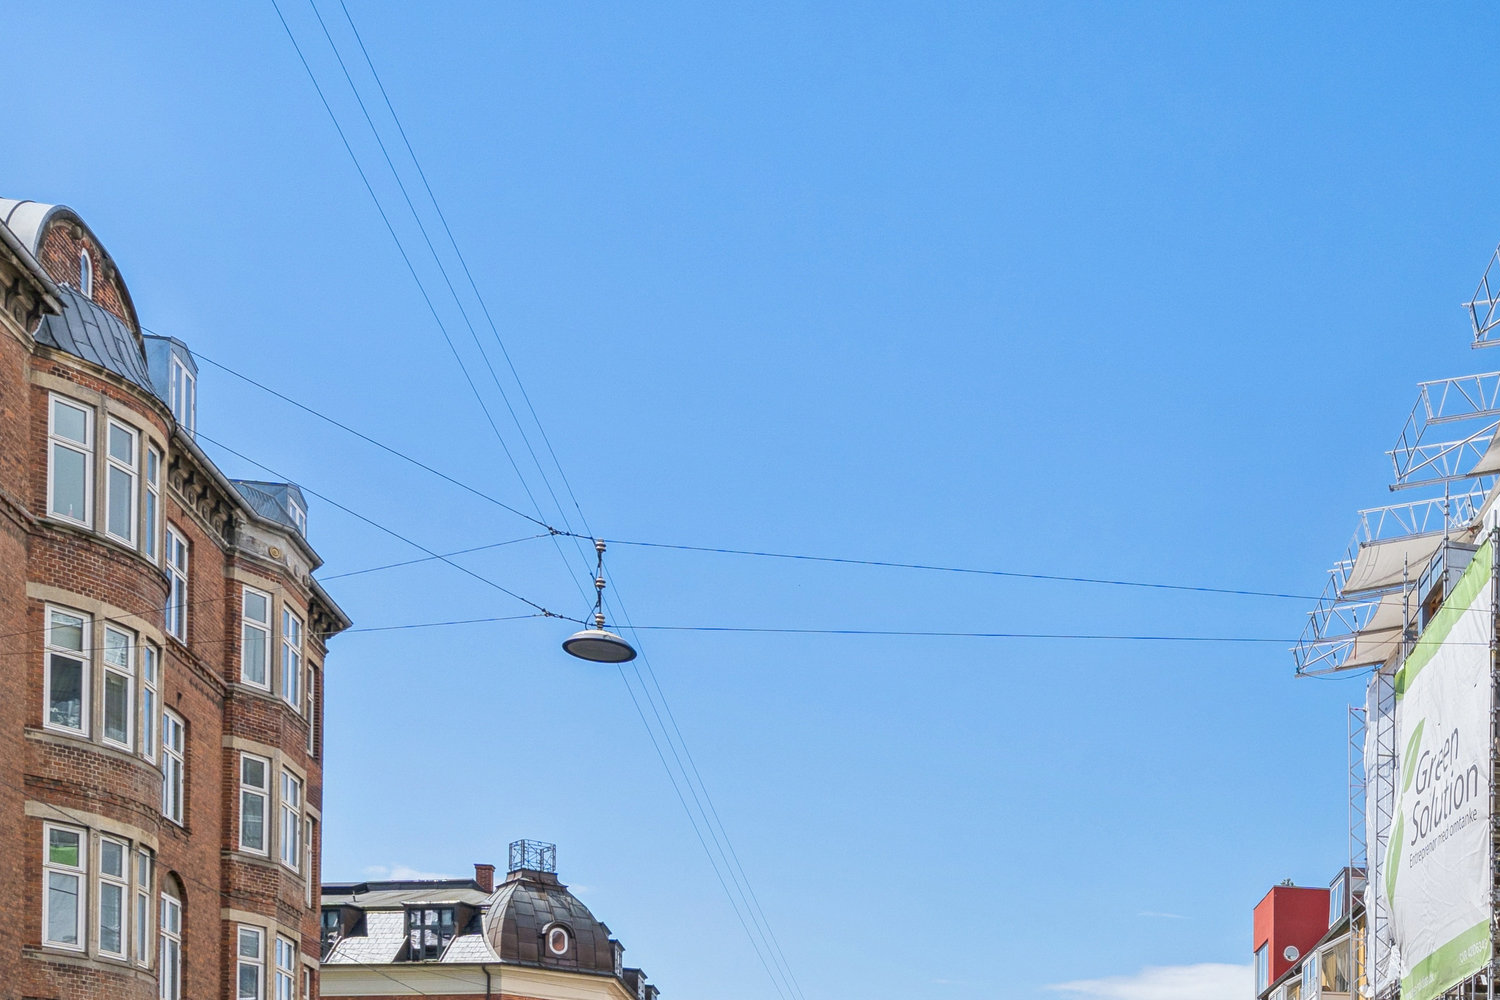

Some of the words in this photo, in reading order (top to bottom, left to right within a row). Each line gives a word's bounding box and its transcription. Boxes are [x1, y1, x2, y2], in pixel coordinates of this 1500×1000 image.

[1415, 727, 1459, 795] Green
[1411, 763, 1478, 847] Solution
[1449, 807, 1478, 837] omtanke
